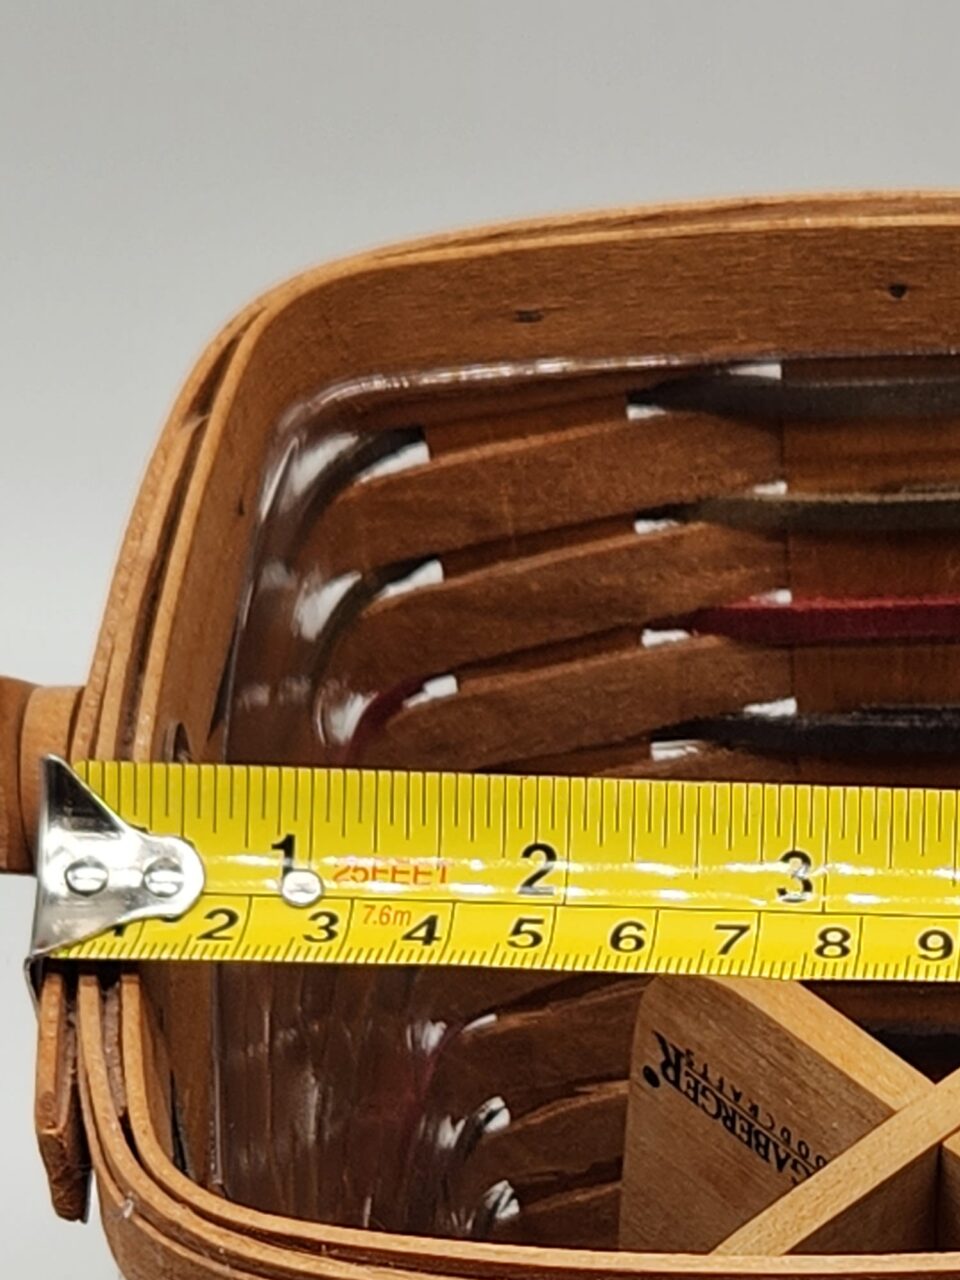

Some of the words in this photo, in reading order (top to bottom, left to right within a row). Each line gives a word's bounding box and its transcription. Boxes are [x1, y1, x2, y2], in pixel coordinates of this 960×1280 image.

[271, 833, 296, 881] 1
[518, 843, 558, 896] 2
[776, 850, 814, 903] 3
[197, 908, 239, 941] 2
[303, 911, 339, 943] 3
[402, 914, 442, 946] 4
[507, 918, 544, 949] 5
[610, 921, 648, 953] 6
[713, 924, 751, 955] 7
[814, 928, 851, 959] 8
[917, 930, 955, 961] 9
[362, 904, 412, 926] 7.6m
